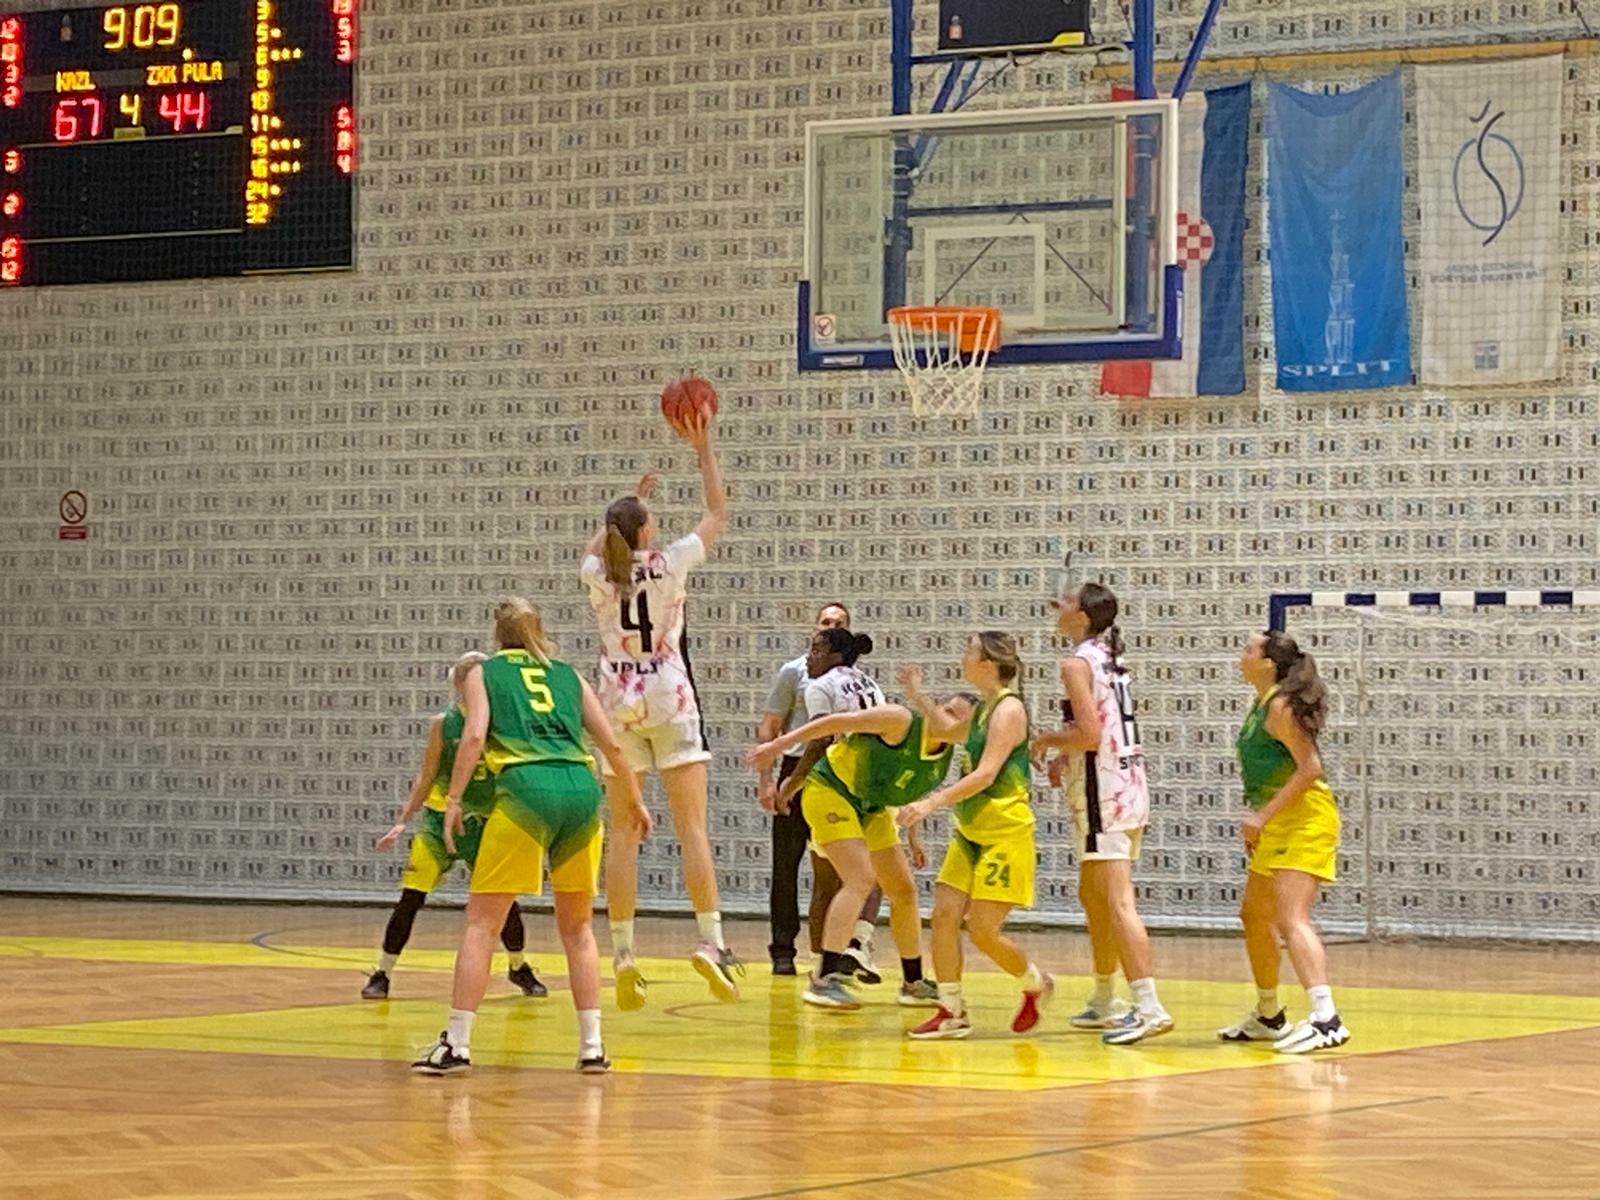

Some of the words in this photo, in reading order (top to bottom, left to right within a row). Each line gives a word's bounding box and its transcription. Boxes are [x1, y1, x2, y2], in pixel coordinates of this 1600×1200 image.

[256, 22, 269, 43] 5
[336, 39, 352, 62] 3
[182, 61, 223, 83] PULA
[56, 98, 100, 141] 67
[120, 93, 140, 126] 4
[159, 91, 206, 131] 44
[251, 114, 269, 132] 11
[1280, 358, 1402, 377] SPLIT
[621, 589, 654, 653] 4
[519, 667, 555, 712] 5
[984, 862, 1010, 889] 24
